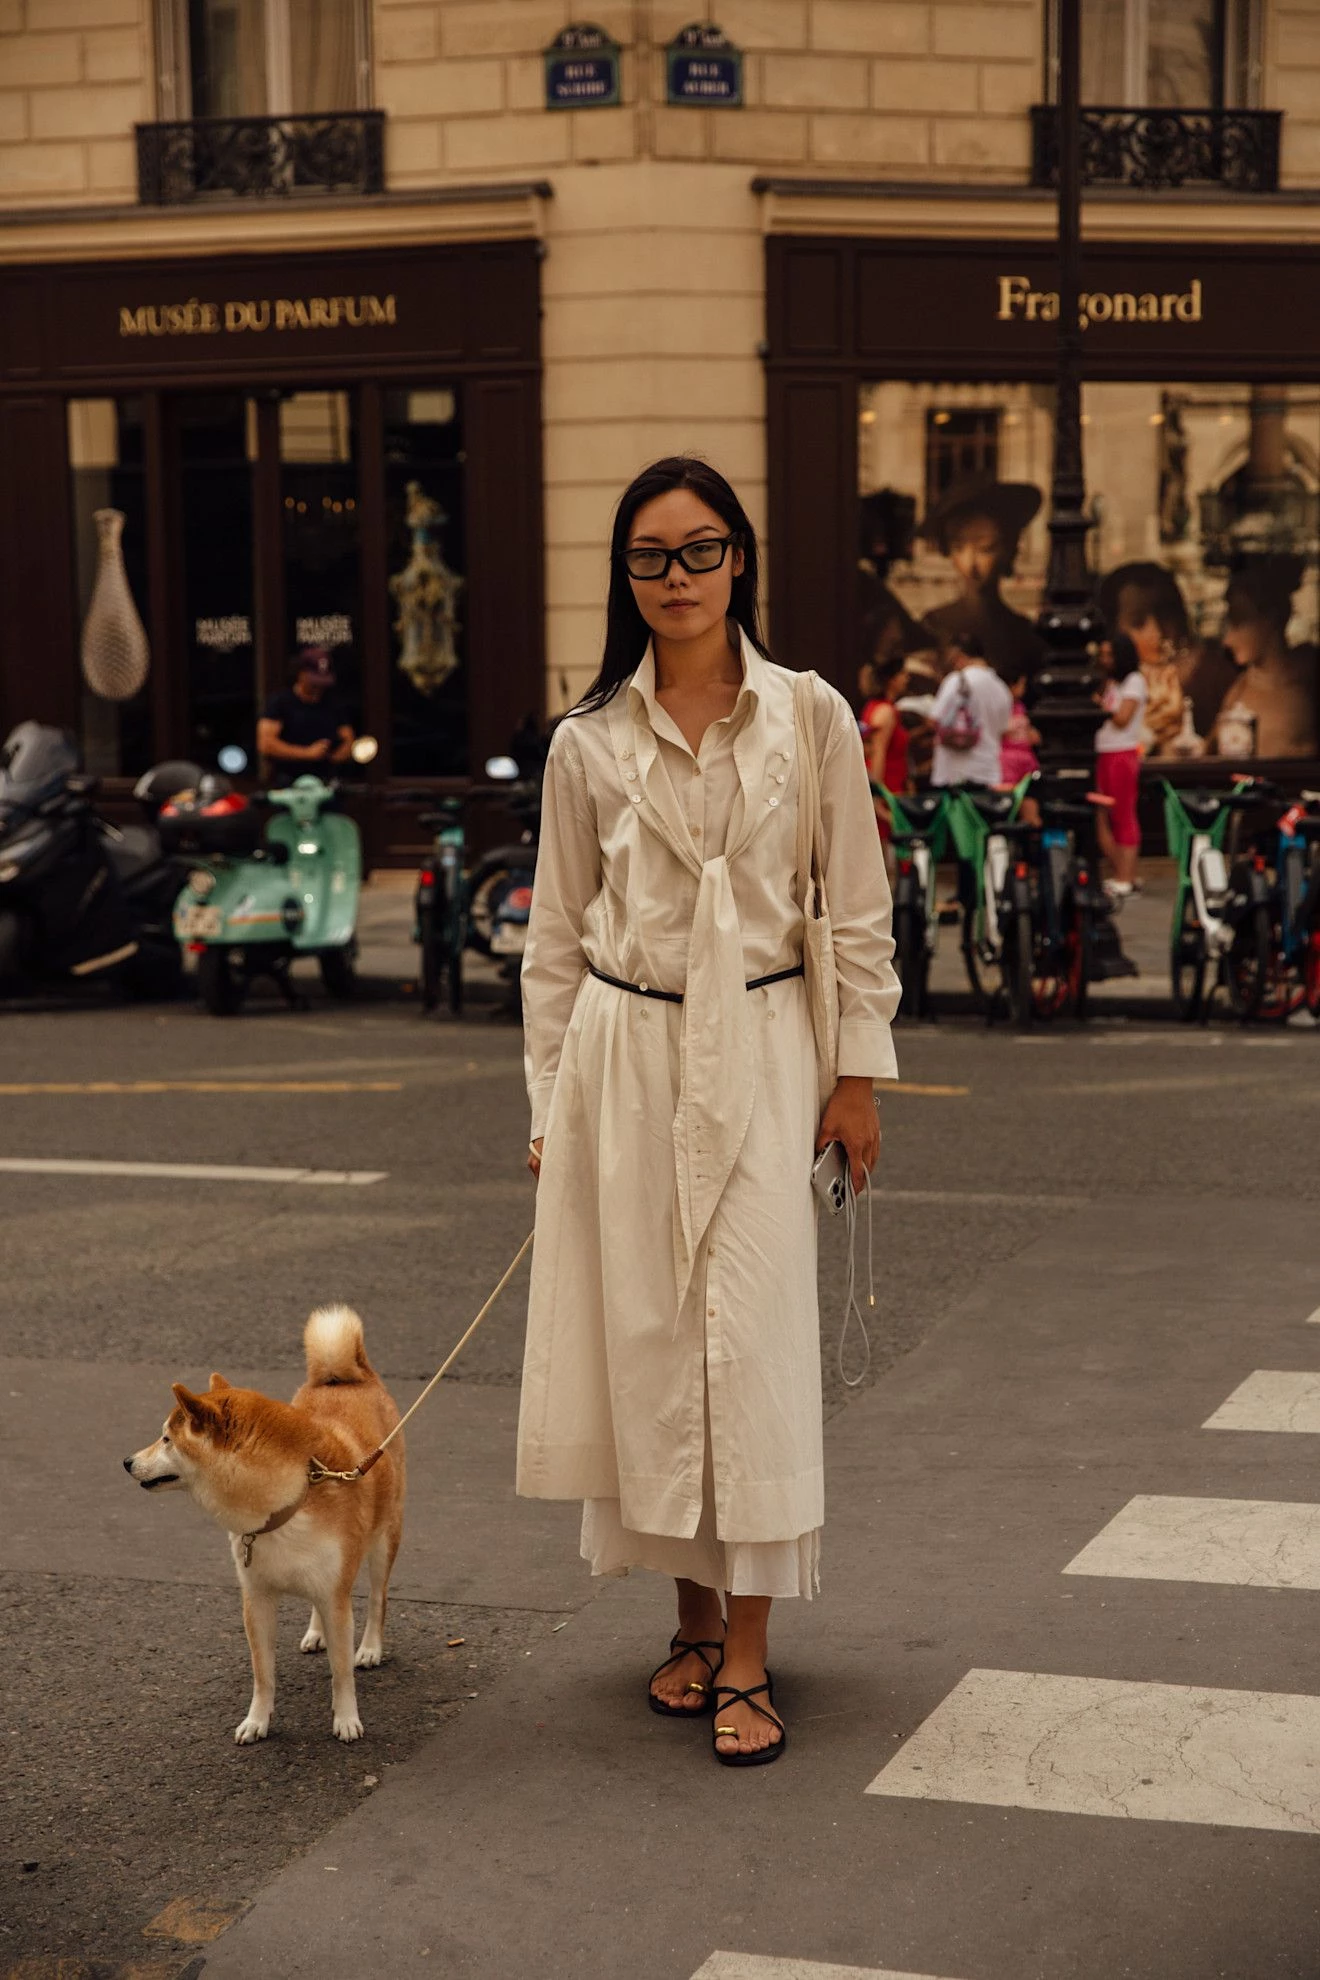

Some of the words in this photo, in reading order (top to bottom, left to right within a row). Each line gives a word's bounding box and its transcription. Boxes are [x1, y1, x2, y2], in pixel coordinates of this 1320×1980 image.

[119, 298, 220, 336] MUSÉE
[224, 300, 271, 332] DU
[275, 294, 397, 331] PARFUM
